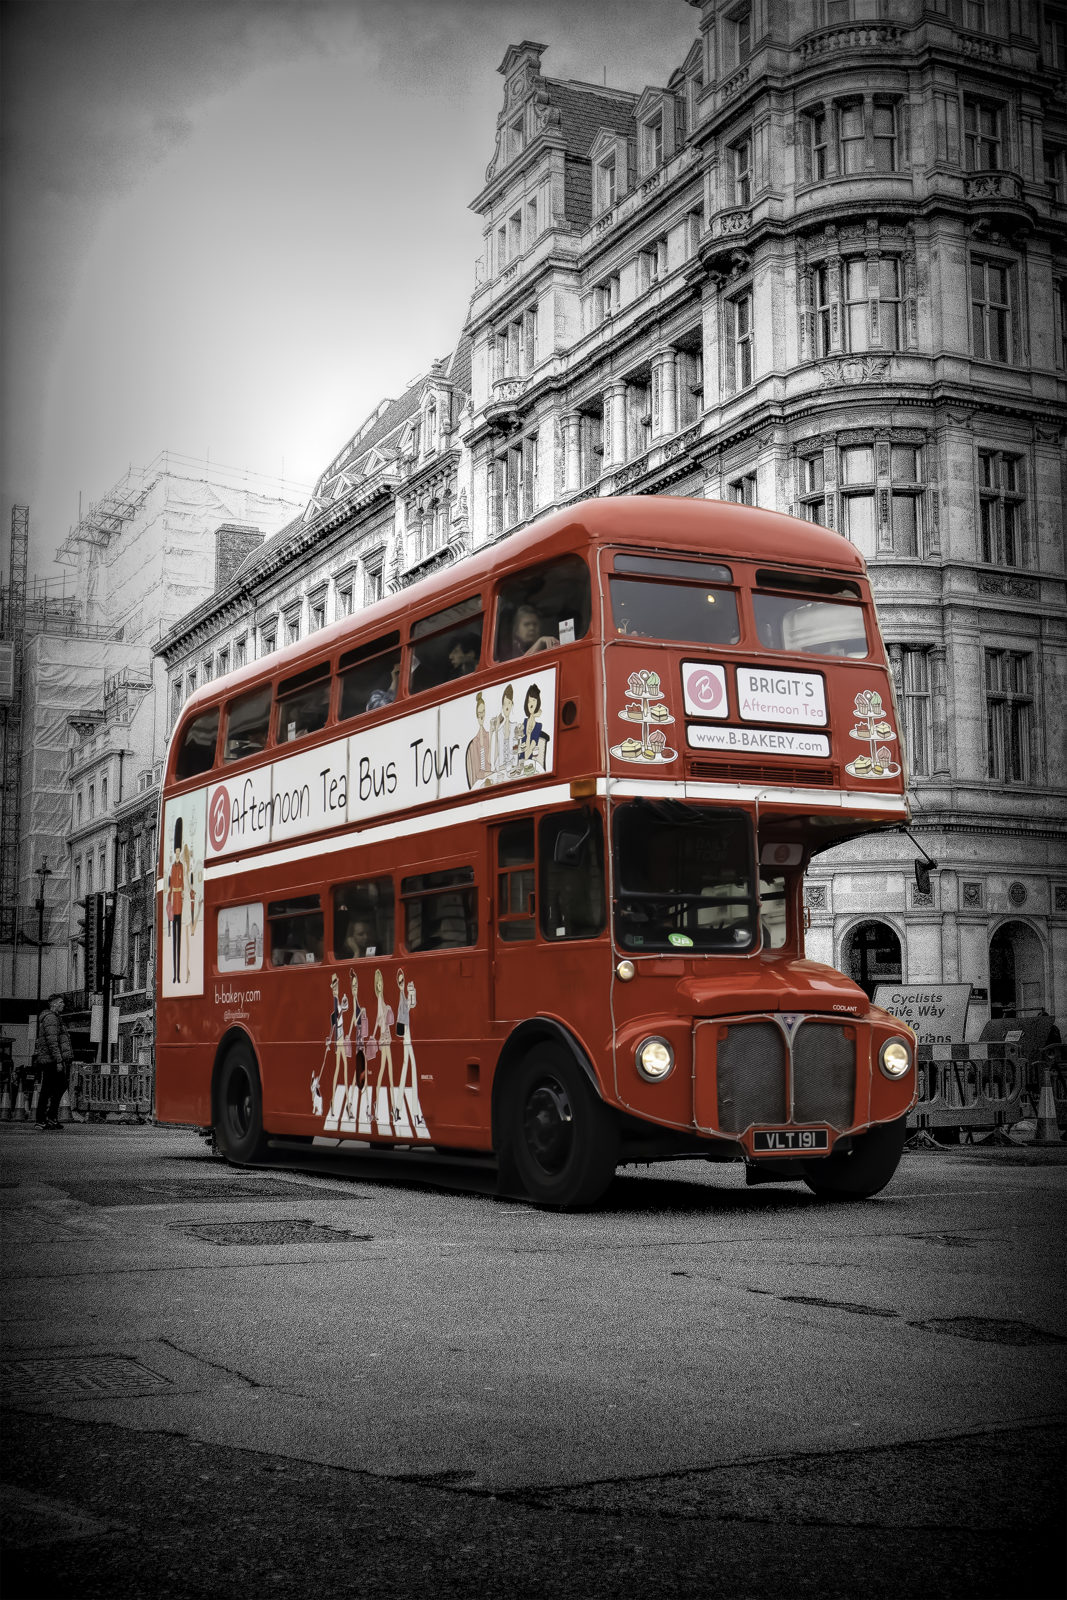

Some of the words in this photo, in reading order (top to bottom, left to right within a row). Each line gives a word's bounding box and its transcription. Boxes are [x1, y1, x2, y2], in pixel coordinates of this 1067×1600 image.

[749, 676, 814, 697] BRIGIT'S
[742, 698, 799, 715] Afternoon
[802, 703, 824, 718] Tea
[696, 732, 822, 751] www.B-BAKERY.com
[230, 779, 310, 836] Afternoon
[320, 767, 348, 813] Tea
[359, 756, 398, 801] Bus
[410, 738, 461, 787] Tour
[214, 984, 261, 1008] b-bakery.com
[891, 993, 943, 1005] Cyclists
[832, 1004, 858, 1012] COOLANT
[886, 1005, 913, 1016] Give
[918, 1005, 946, 1018] Way
[917, 1032, 952, 1044] rians
[766, 1132, 794, 1148] VLT
[798, 1131, 815, 1147] 191
